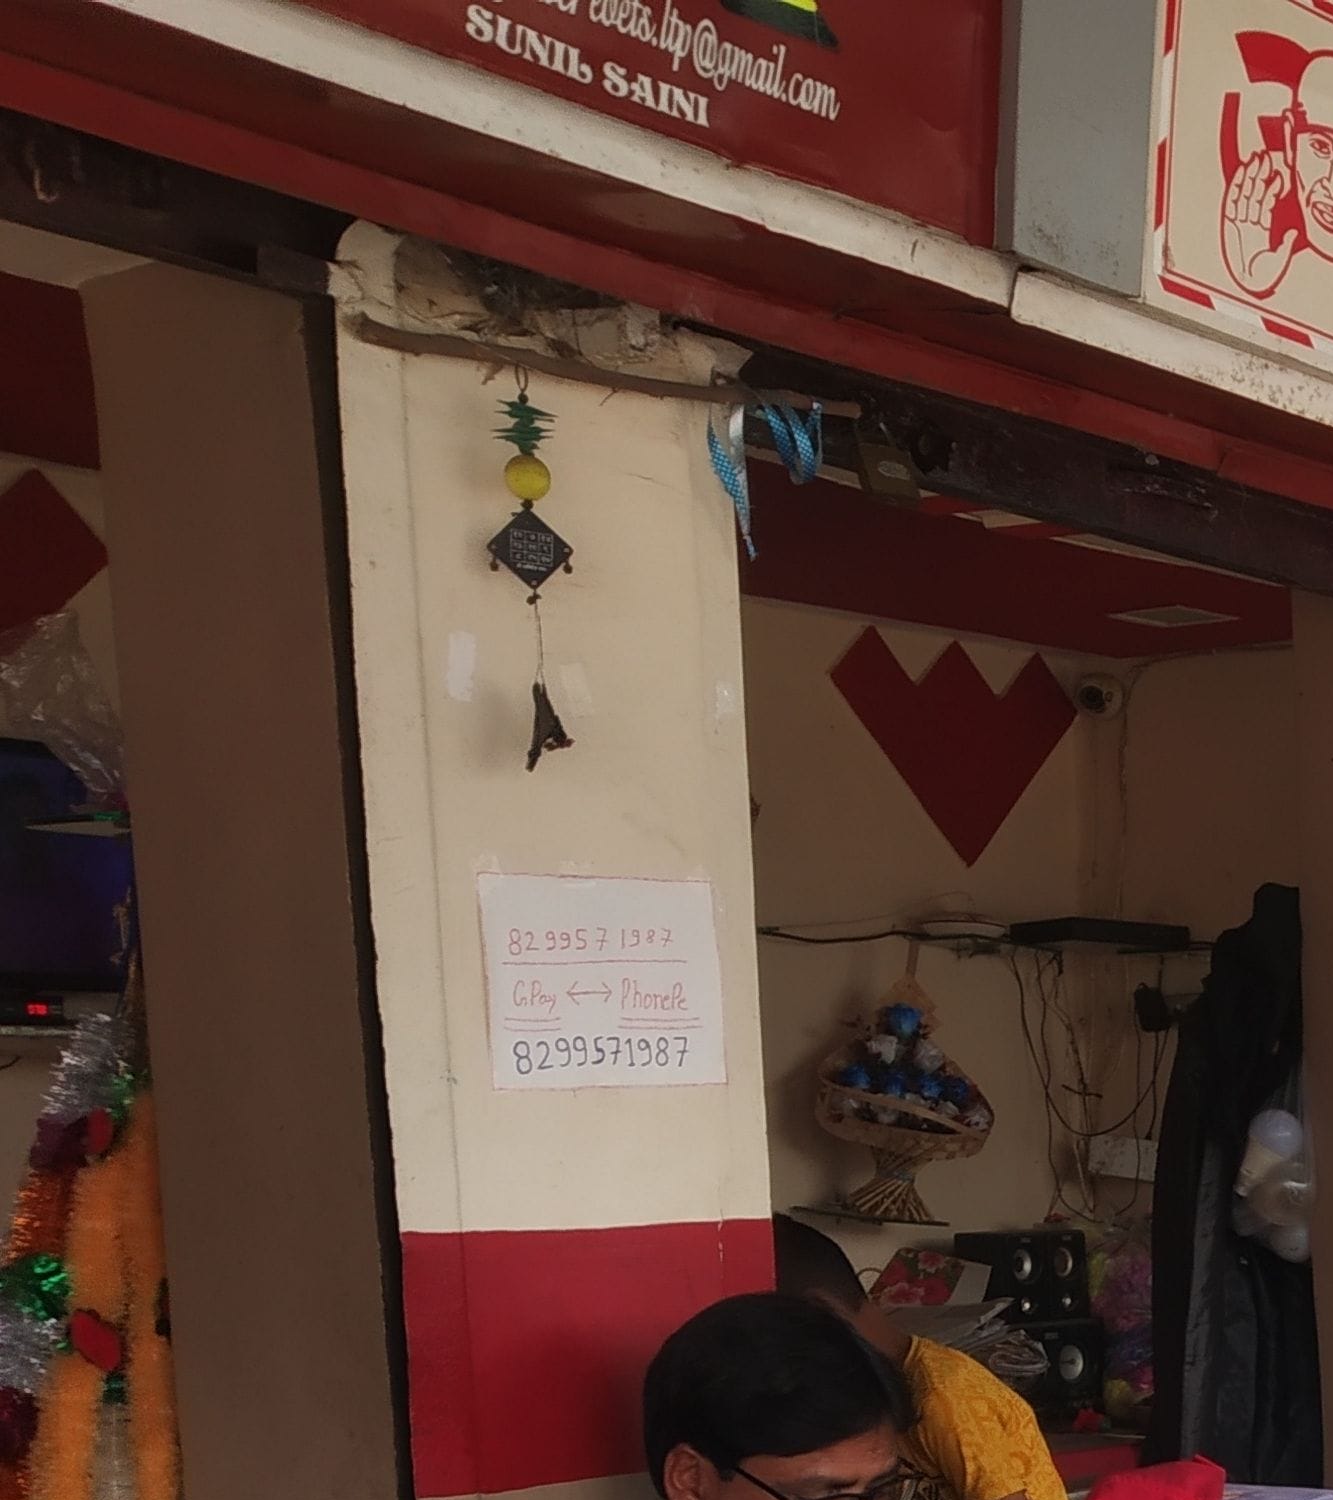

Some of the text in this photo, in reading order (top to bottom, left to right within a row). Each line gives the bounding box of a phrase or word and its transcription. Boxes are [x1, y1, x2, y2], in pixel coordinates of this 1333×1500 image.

[465, 4, 710, 128] SUNIL SAINI
[512, 1035, 690, 1075] 8299571987
